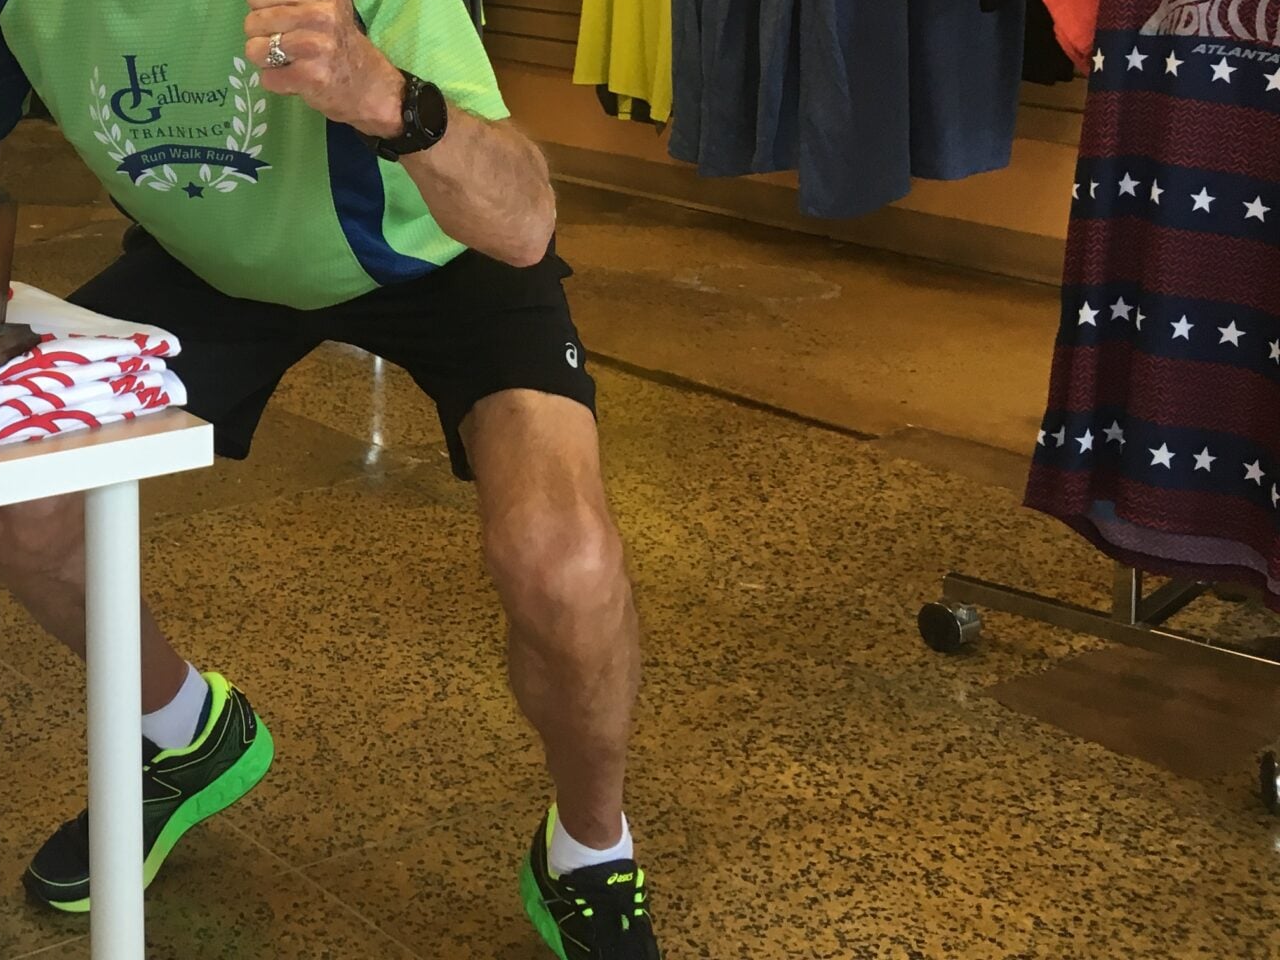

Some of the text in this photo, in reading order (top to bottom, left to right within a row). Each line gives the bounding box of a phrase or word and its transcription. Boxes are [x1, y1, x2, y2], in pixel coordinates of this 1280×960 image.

[1191, 43, 1280, 64] ATLANTA
[122, 54, 169, 109] Jeff
[110, 84, 229, 124] Galloway
[141, 147, 234, 165] Run Walk Run
